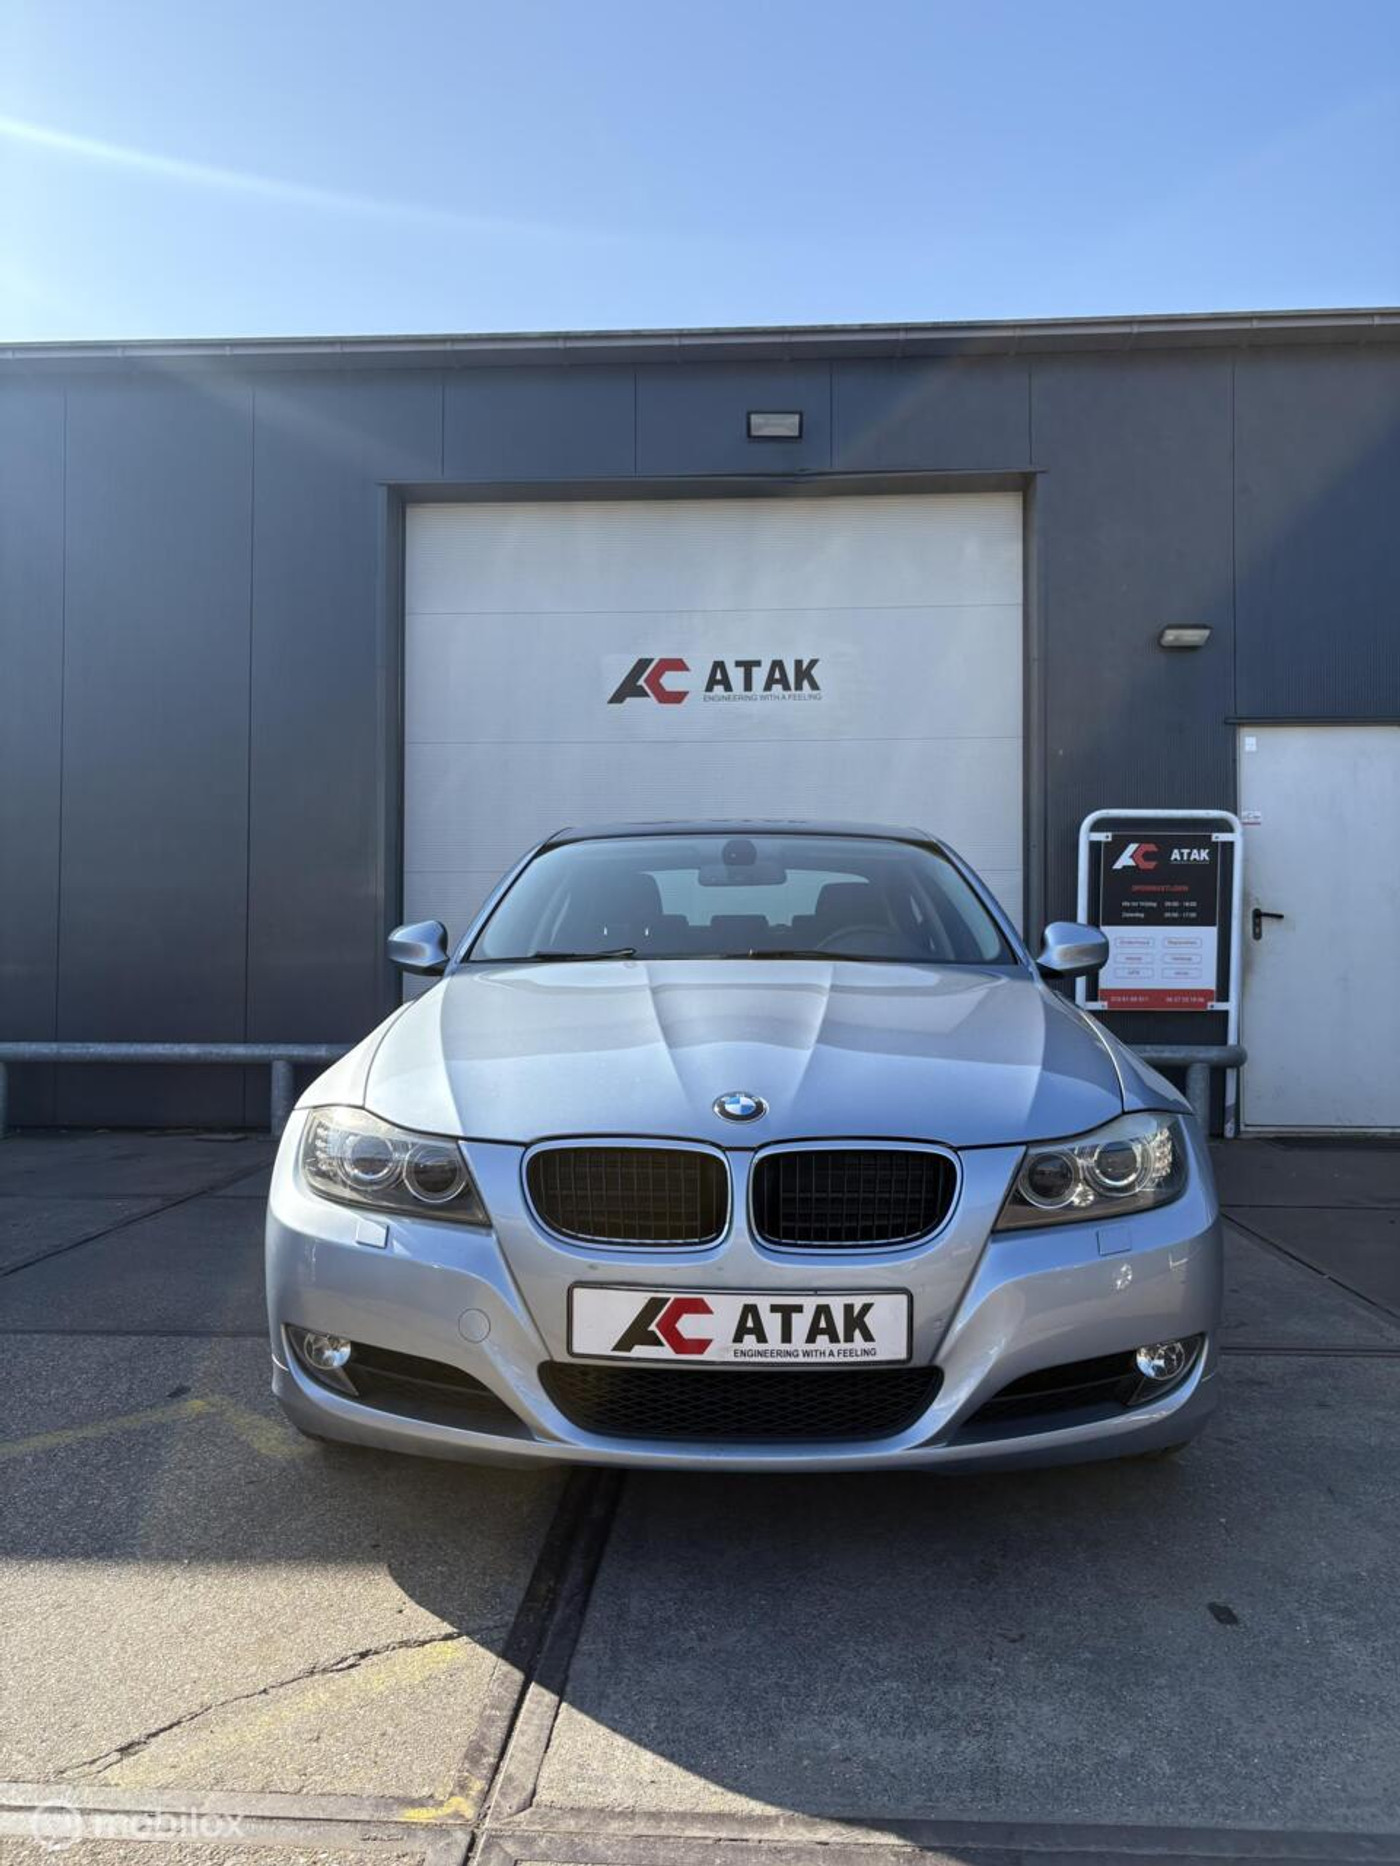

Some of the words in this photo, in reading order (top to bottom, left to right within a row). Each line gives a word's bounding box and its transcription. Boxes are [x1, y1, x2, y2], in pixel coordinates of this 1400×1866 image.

[704, 658, 822, 693] ATAK
[703, 694, 758, 703] ENGINEERING
[759, 694, 780, 702] WITH
[788, 693, 822, 701] FEELING
[1170, 848, 1210, 861] ATAK
[732, 1302, 876, 1344] ATAK
[733, 1348, 799, 1359] ENGINEERING
[802, 1348, 826, 1358] WITH
[827, 1349, 835, 1358] A
[837, 1348, 877, 1358] FEELING
